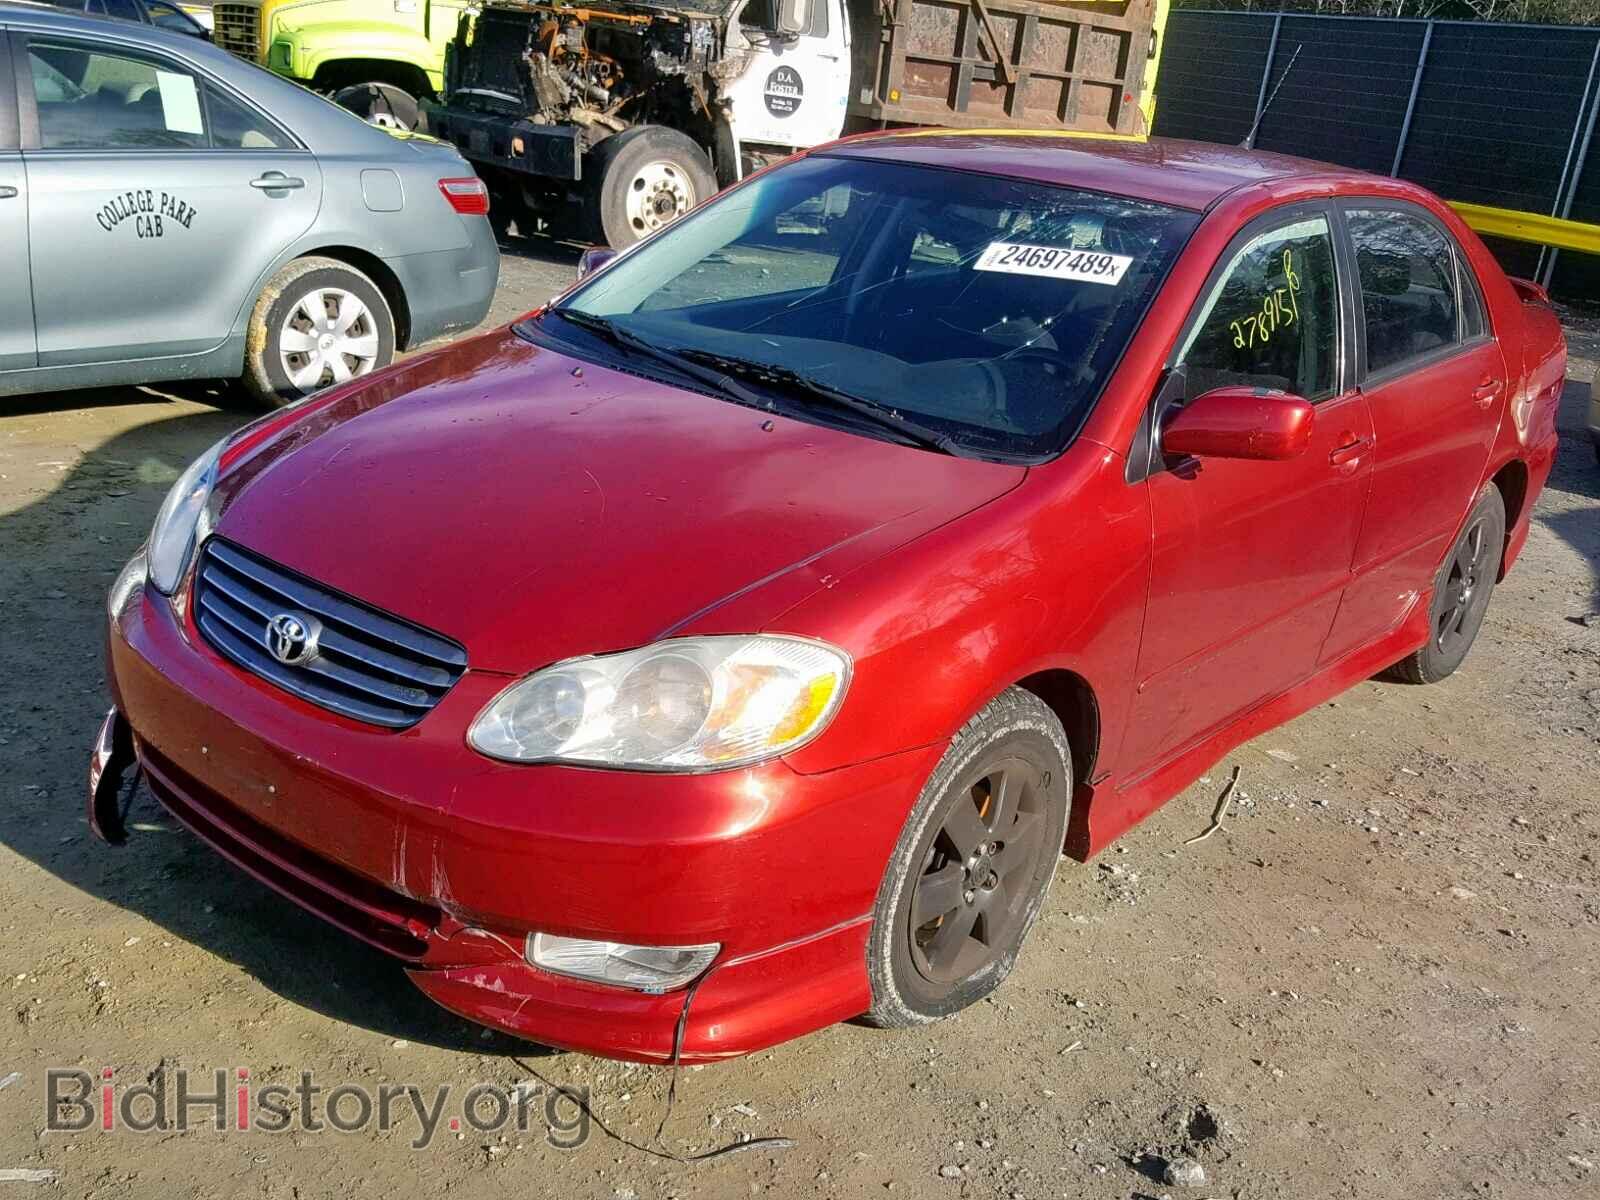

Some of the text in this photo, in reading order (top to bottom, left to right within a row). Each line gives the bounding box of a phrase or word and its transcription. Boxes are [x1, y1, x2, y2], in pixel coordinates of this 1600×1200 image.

[769, 81, 799, 98] FOSTER
[96, 189, 197, 232] COLLEGE PARK
[136, 214, 164, 239] CAB
